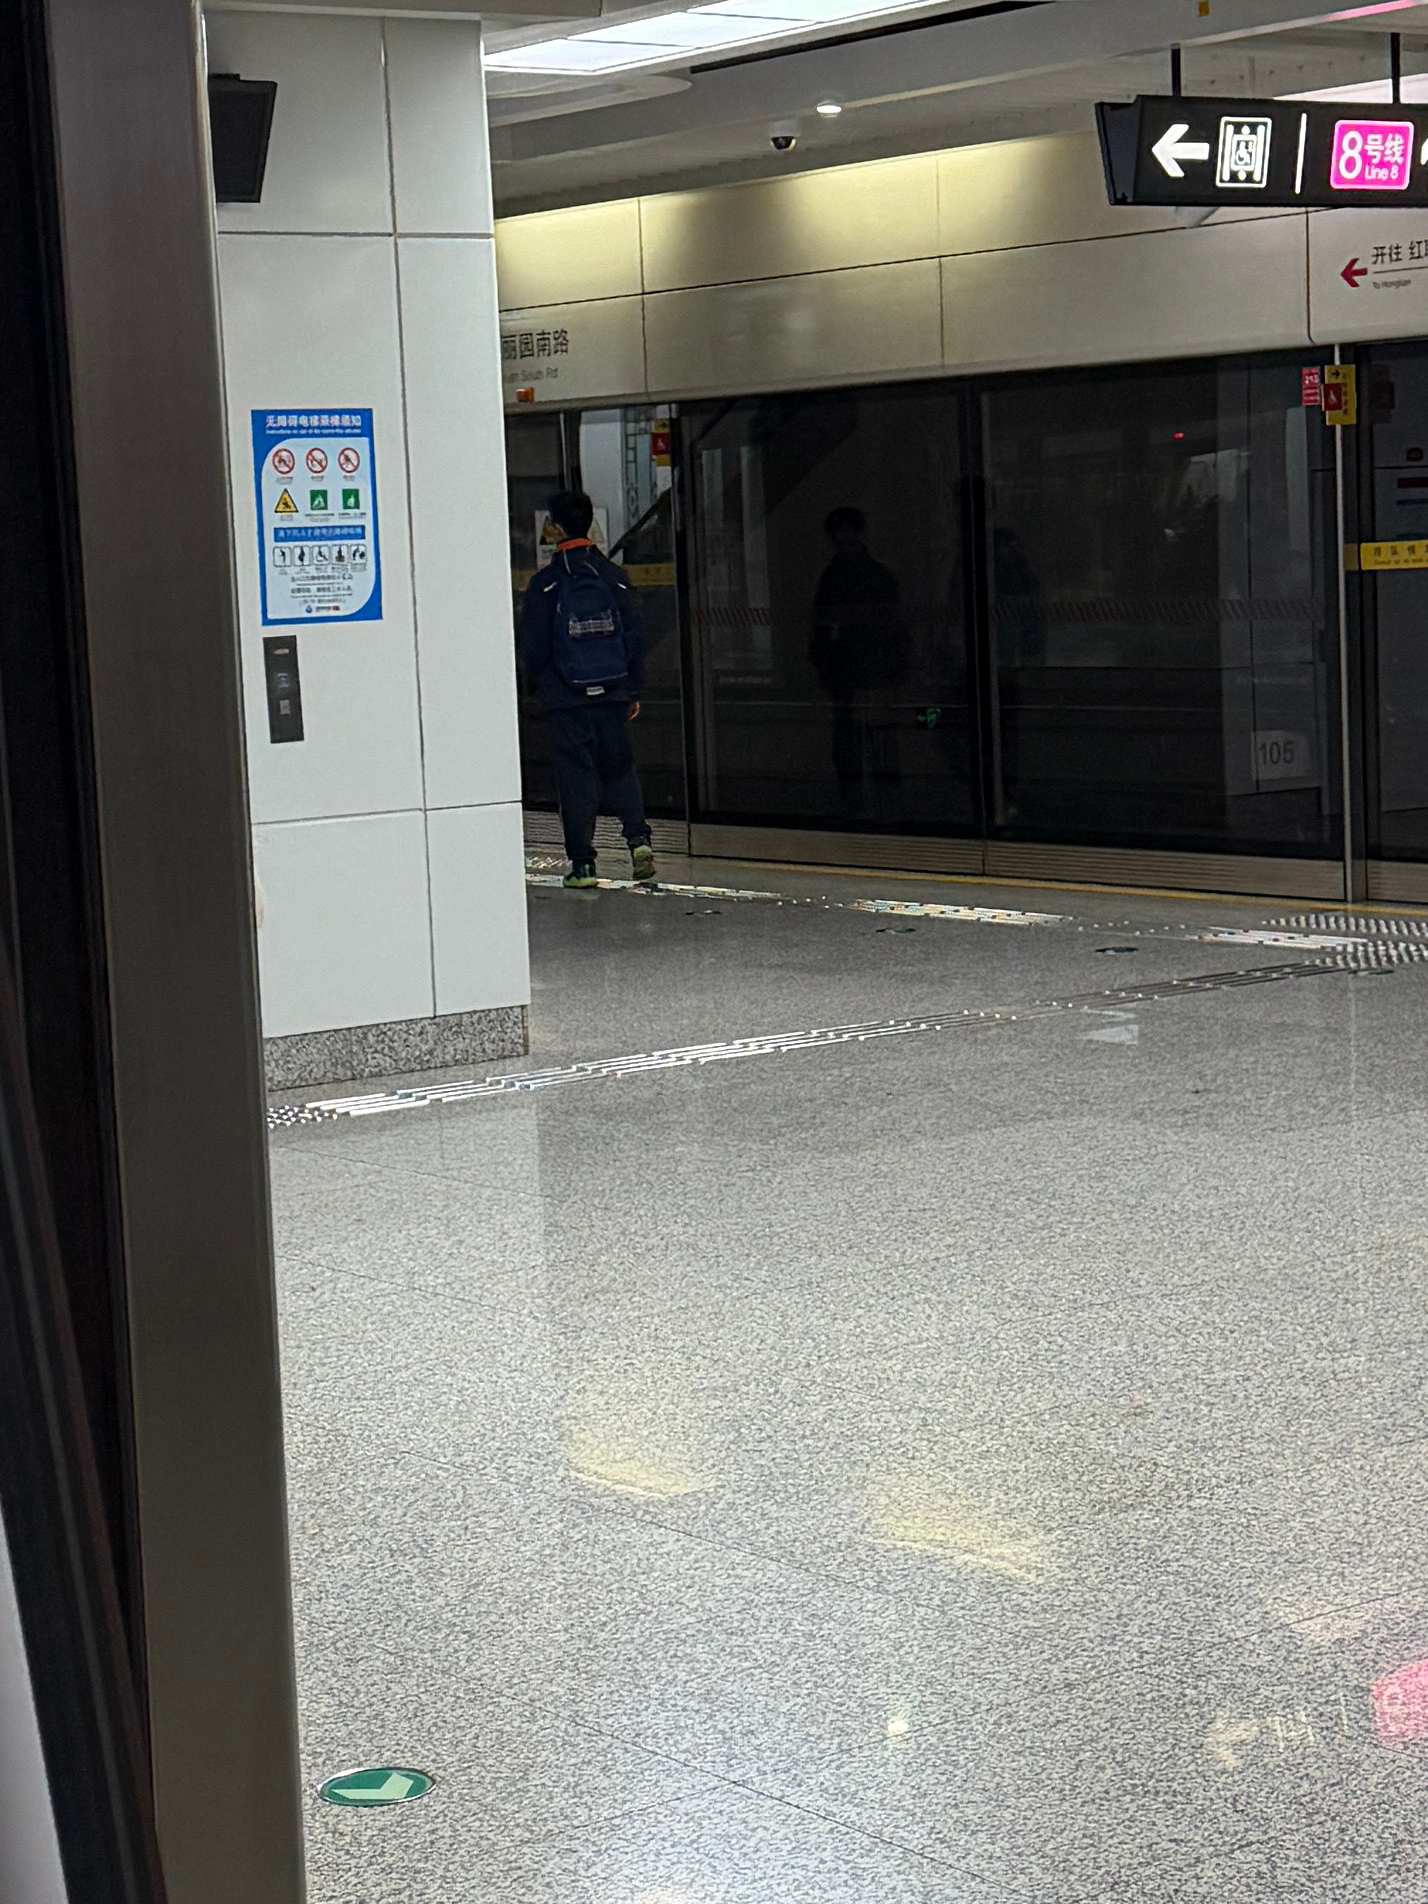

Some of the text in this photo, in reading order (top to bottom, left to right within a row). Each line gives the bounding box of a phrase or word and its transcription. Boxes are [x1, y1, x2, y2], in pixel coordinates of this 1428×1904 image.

[1339, 130, 1405, 180] 8号线
[1365, 165, 1400, 180] Line 8
[1371, 243, 1403, 264] 开往
[501, 328, 568, 360] 丽园南路
[1259, 738, 1295, 765] 105
